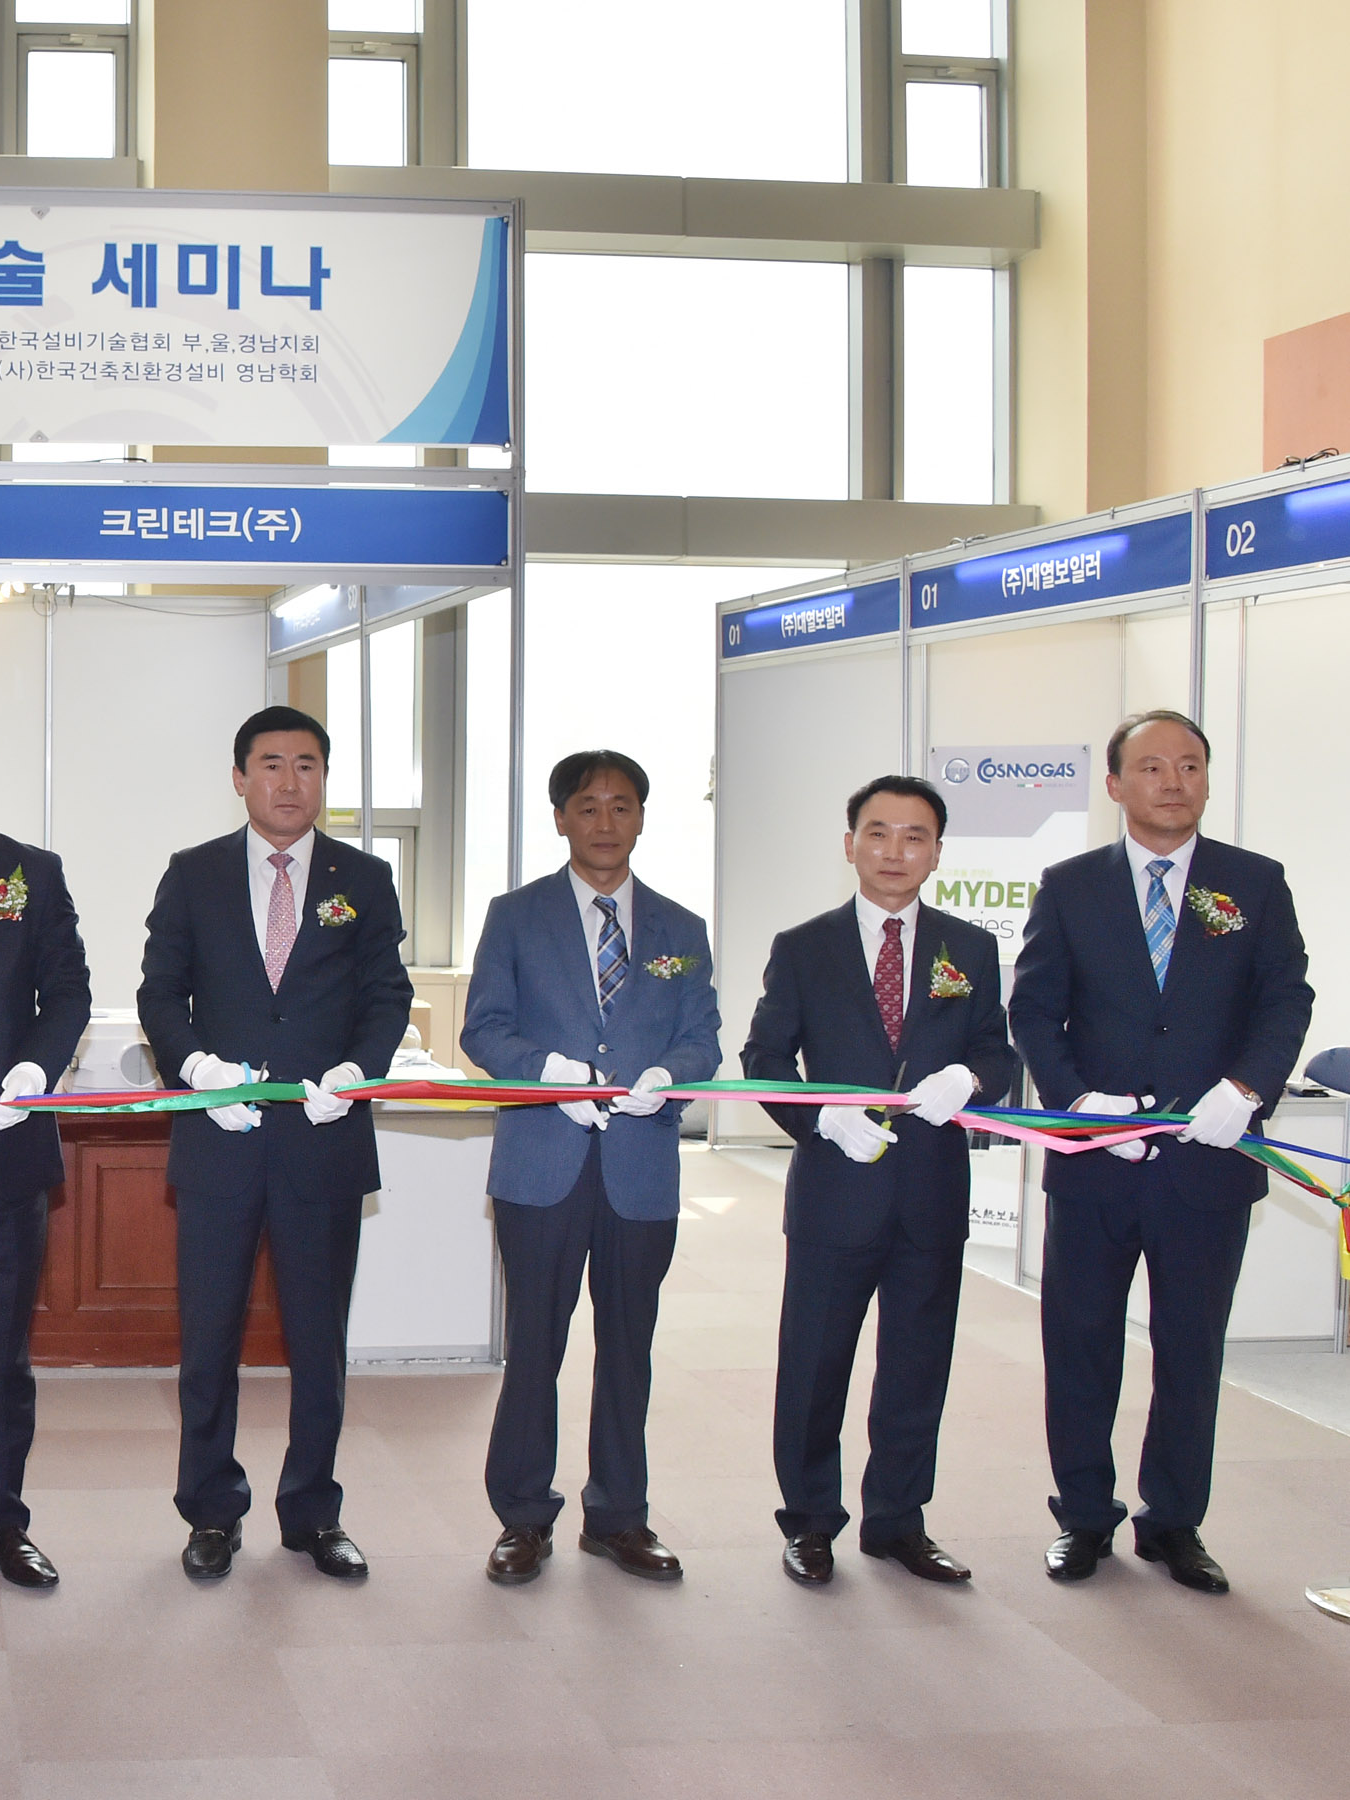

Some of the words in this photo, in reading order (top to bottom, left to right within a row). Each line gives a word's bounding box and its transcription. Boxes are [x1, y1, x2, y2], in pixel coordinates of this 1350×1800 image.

[91, 243, 331, 311] 세미나
[236, 363, 317, 383] 영남학회
[99, 507, 302, 544] 크린테크(주)
[1226, 520, 1256, 557] 02
[1001, 550, 1101, 598] (주)대열보일러
[921, 583, 938, 610] 01
[728, 624, 740, 646] 01
[781, 603, 845, 639] (주)대열보일러
[977, 758, 1076, 784] COSMOGAS
